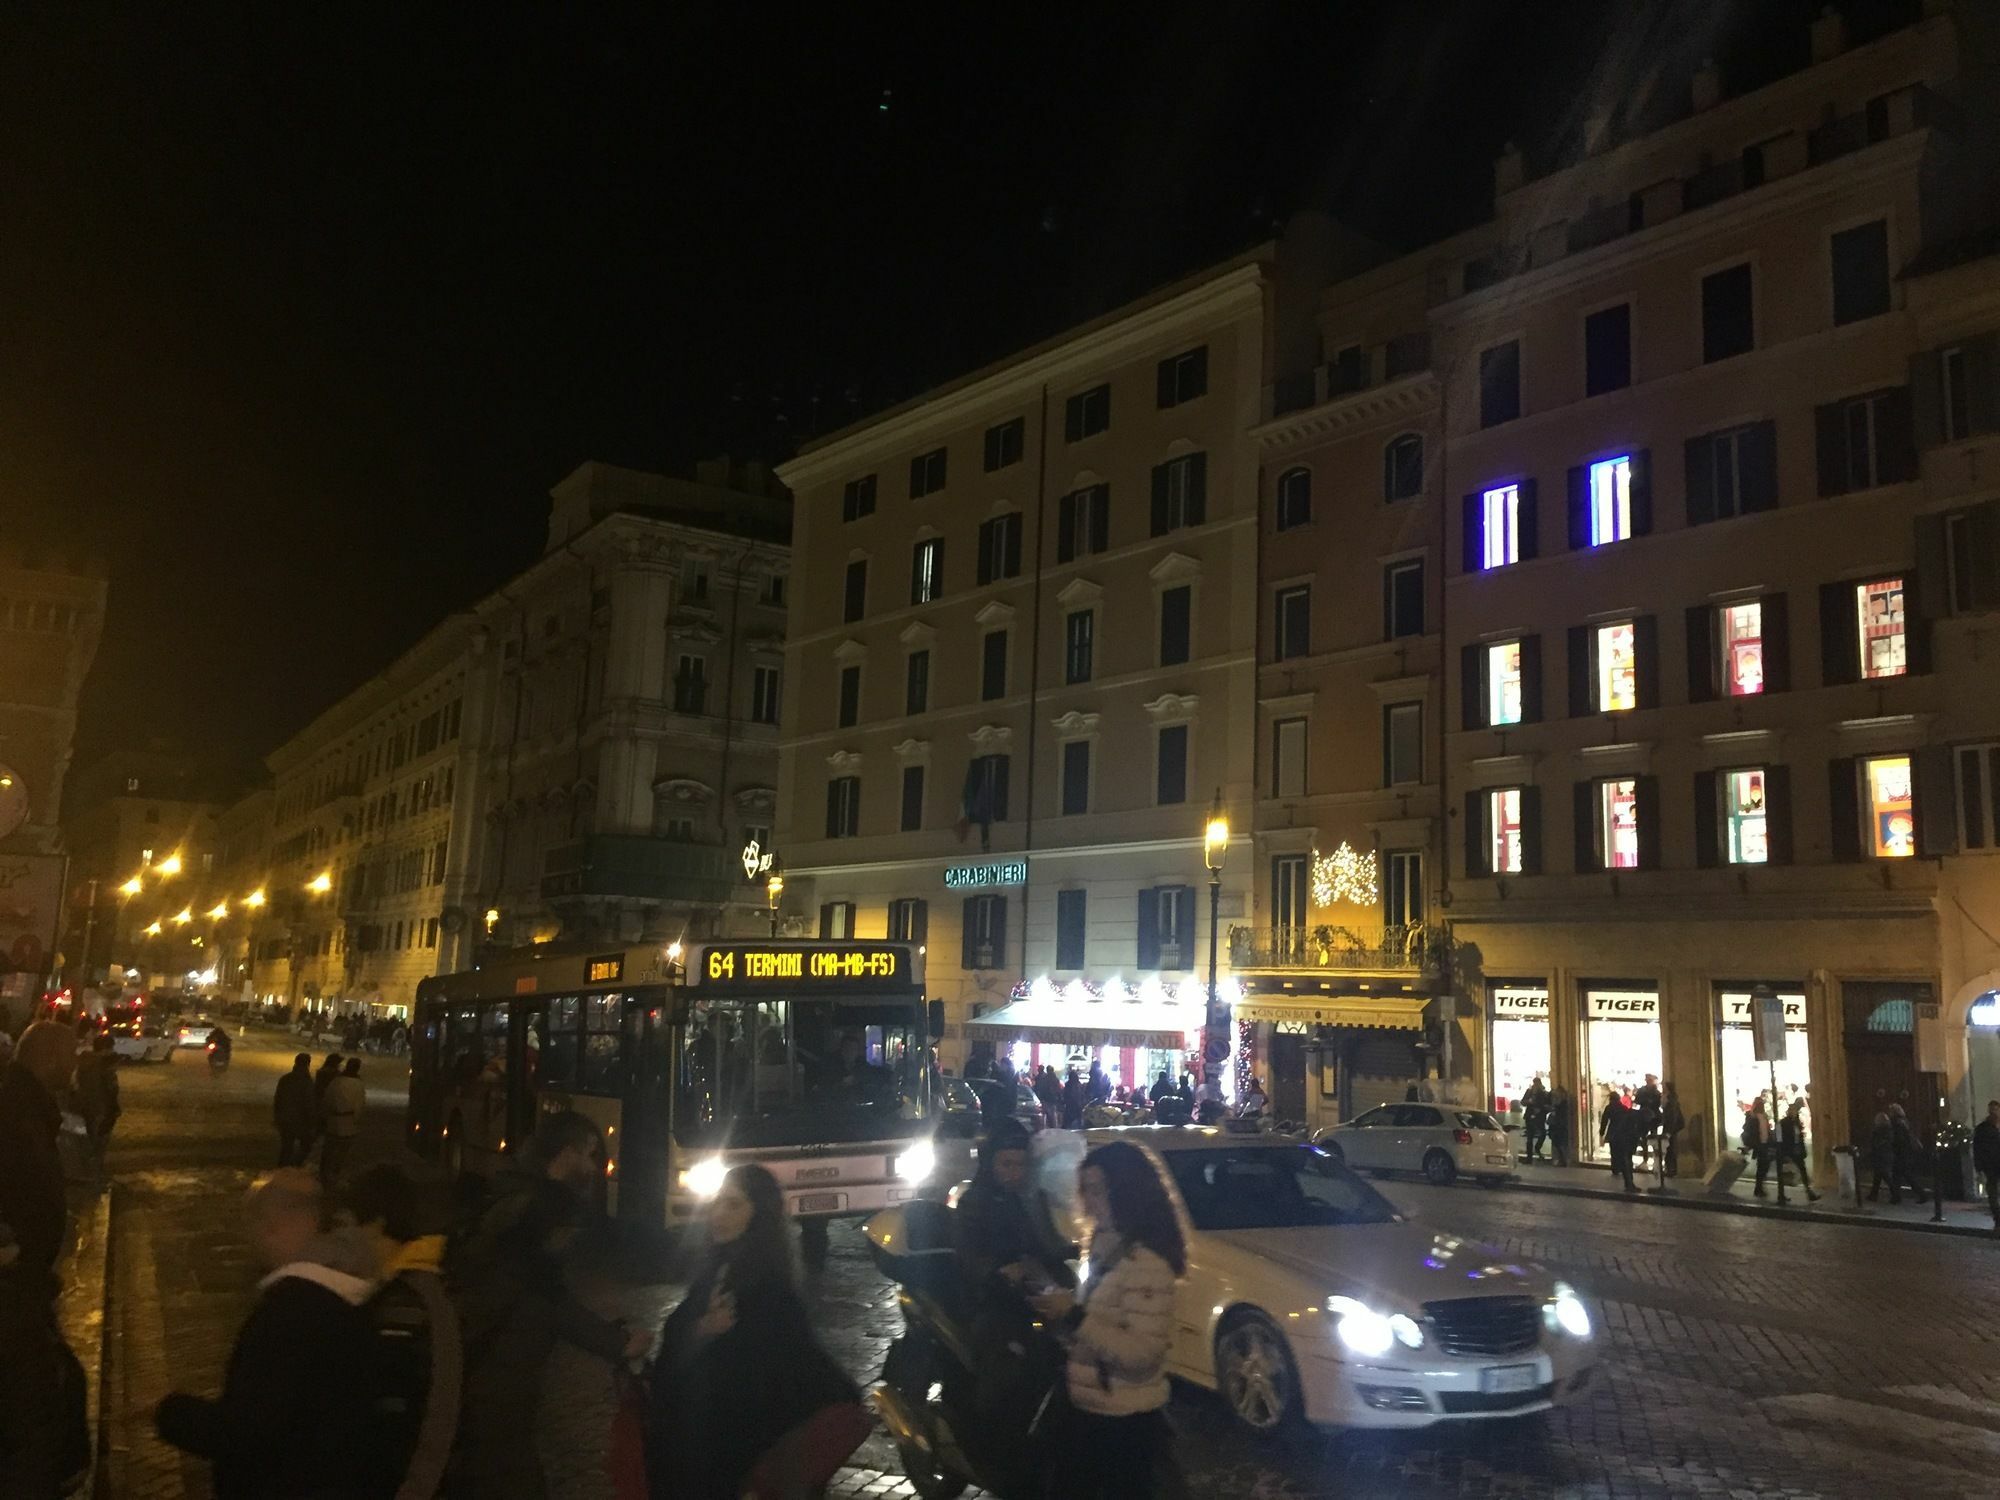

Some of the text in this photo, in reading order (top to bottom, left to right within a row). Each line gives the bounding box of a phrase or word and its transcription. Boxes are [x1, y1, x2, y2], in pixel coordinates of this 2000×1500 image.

[944, 863, 1026, 885] CARABINIERI
[709, 952, 895, 978] 64 TERMINI (MA-MB-FS)
[1595, 999, 1656, 1012] TIGER
[1731, 1002, 1800, 1015] TIR
